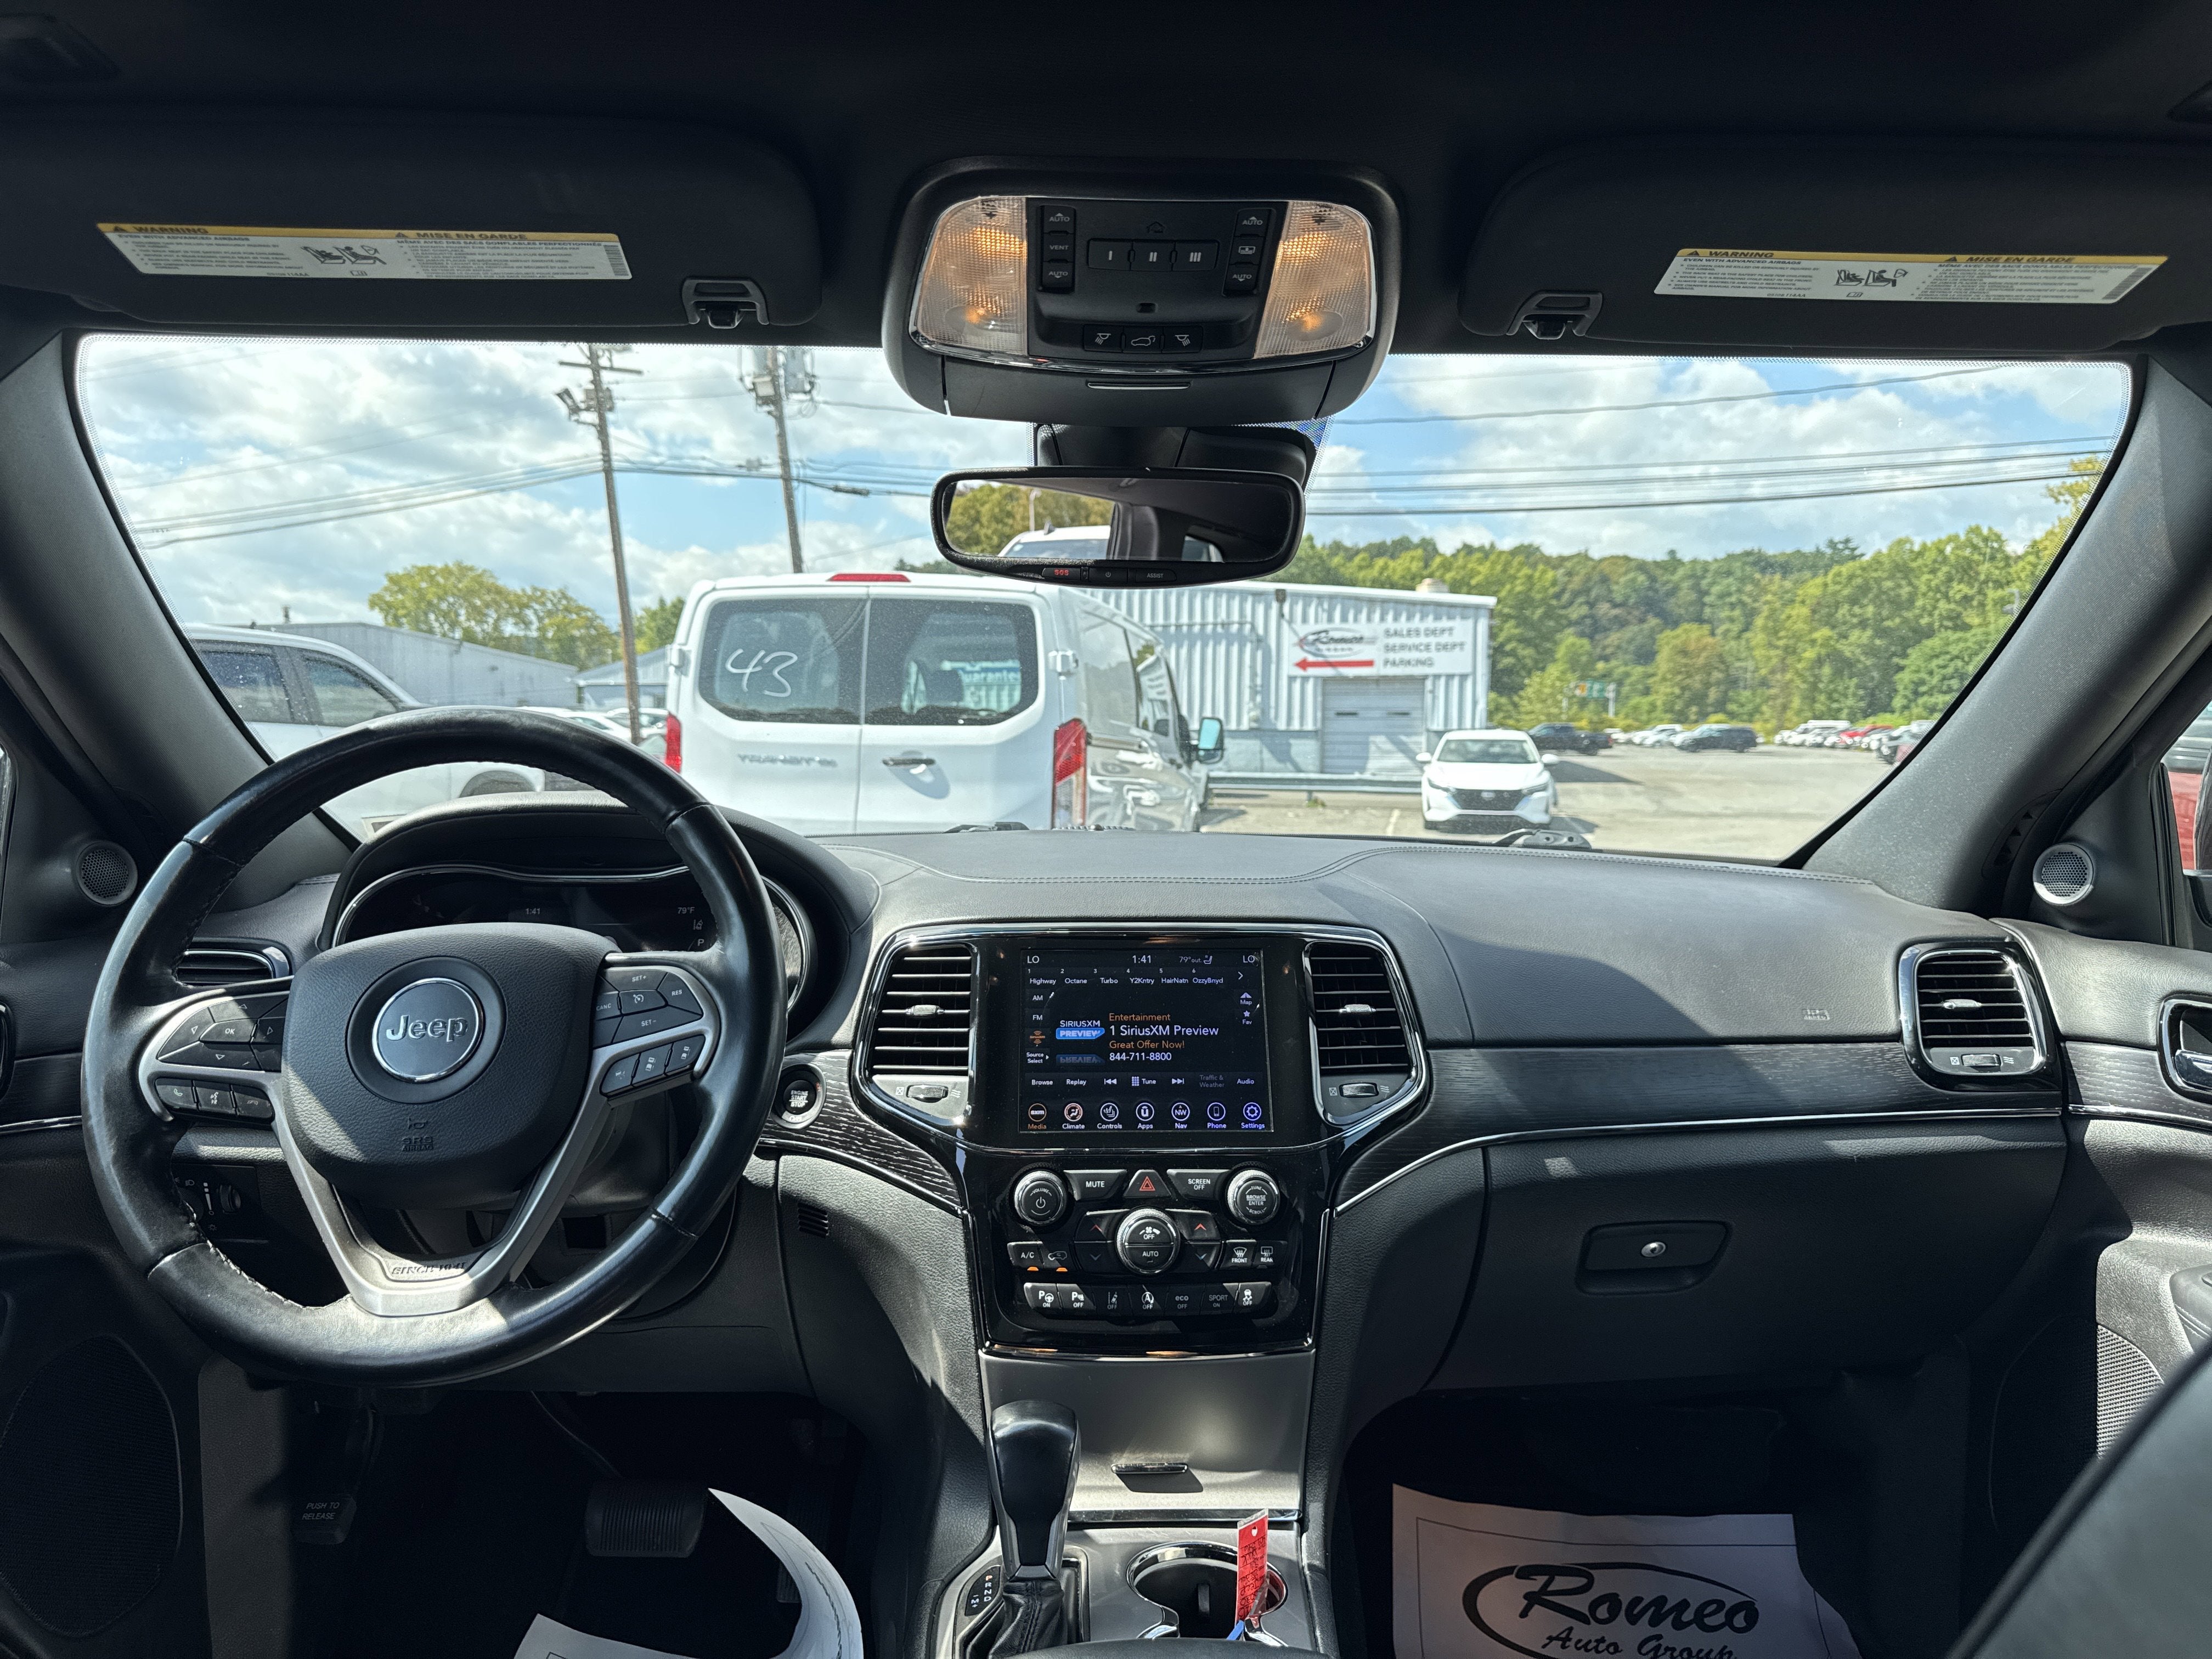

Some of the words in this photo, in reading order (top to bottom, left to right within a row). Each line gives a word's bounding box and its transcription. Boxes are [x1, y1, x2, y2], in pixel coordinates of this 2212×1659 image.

[133, 225, 209, 234] WARNING
[1383, 627, 1421, 639] SALES
[1423, 627, 1455, 638] DEPT
[1383, 642, 1432, 653] SERVICE
[1434, 641, 1466, 652] DEPT
[1383, 657, 1435, 669] PARKING
[725, 649, 798, 698] 43
[525, 907, 541, 915] 1:41
[1027, 955, 1040, 964] LO
[1132, 955, 1152, 964] 1:41
[1243, 955, 1255, 963] LO
[1129, 977, 1155, 985] Y2Kntry
[596, 1003, 612, 1011] CANC
[1109, 1013, 1171, 1022] Entertainment
[224, 1026, 235, 1036] OK
[385, 1014, 469, 1043] Jeep
[1110, 1025, 1115, 1036] 1
[1120, 1025, 1169, 1036] SiriusXM
[1173, 1025, 1220, 1036] Preview
[1109, 1041, 1135, 1049] Great
[1137, 1041, 1160, 1049] Offer
[1161, 1040, 1186, 1049] Now!
[1109, 1052, 1172, 1061] 844-711-8800
[402, 1136, 433, 1145] SRS
[302, 1512, 336, 1520] RELEASE
[1514, 1563, 1760, 1635] Romeo
[1541, 1624, 1623, 1655] Auto
[1637, 1633, 1737, 1659] Group
